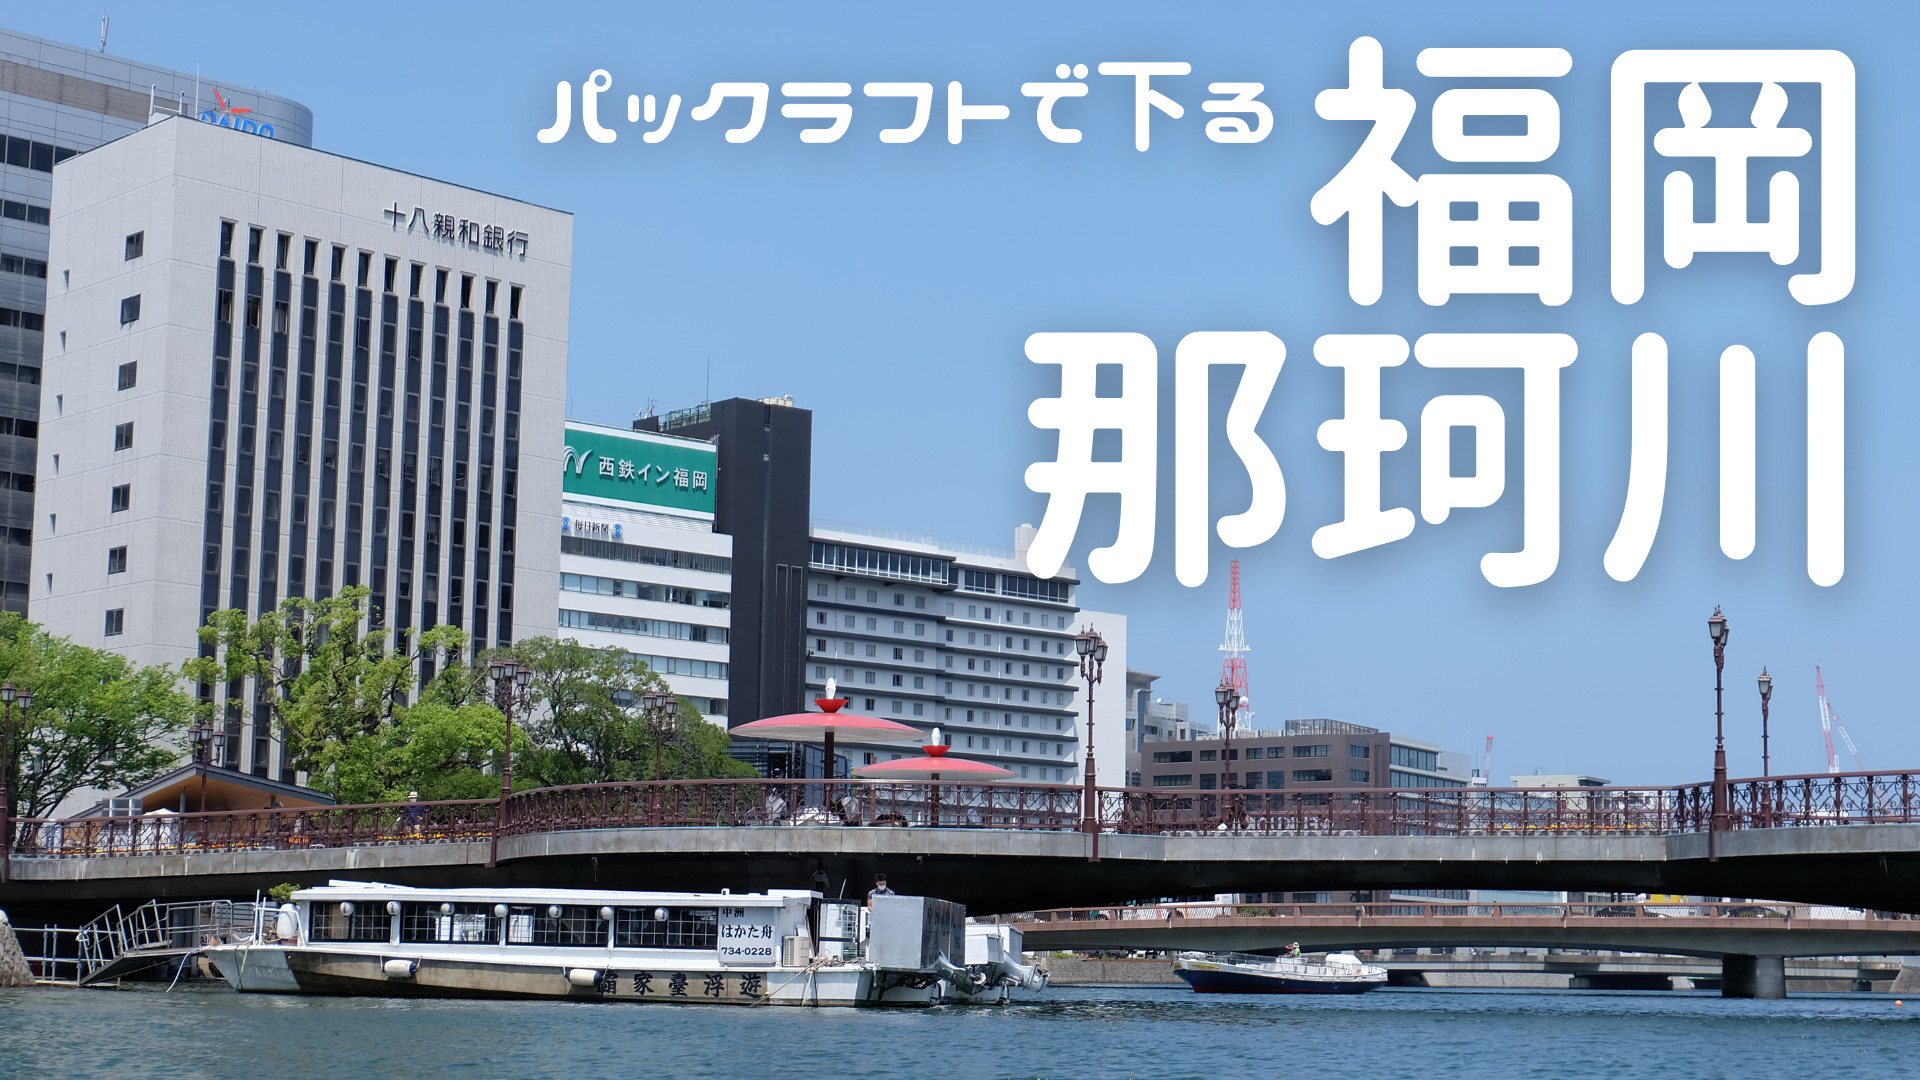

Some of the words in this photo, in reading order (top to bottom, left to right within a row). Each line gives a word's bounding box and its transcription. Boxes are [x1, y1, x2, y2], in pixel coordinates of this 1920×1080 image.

[384, 201, 529, 256] 十八親和銀行
[599, 456, 707, 490] 西鉄イン福岡
[575, 519, 609, 533] 毎日新聞
[722, 907, 745, 918] 中洲
[721, 924, 773, 940] はかた舟
[721, 946, 772, 956] 734-0228
